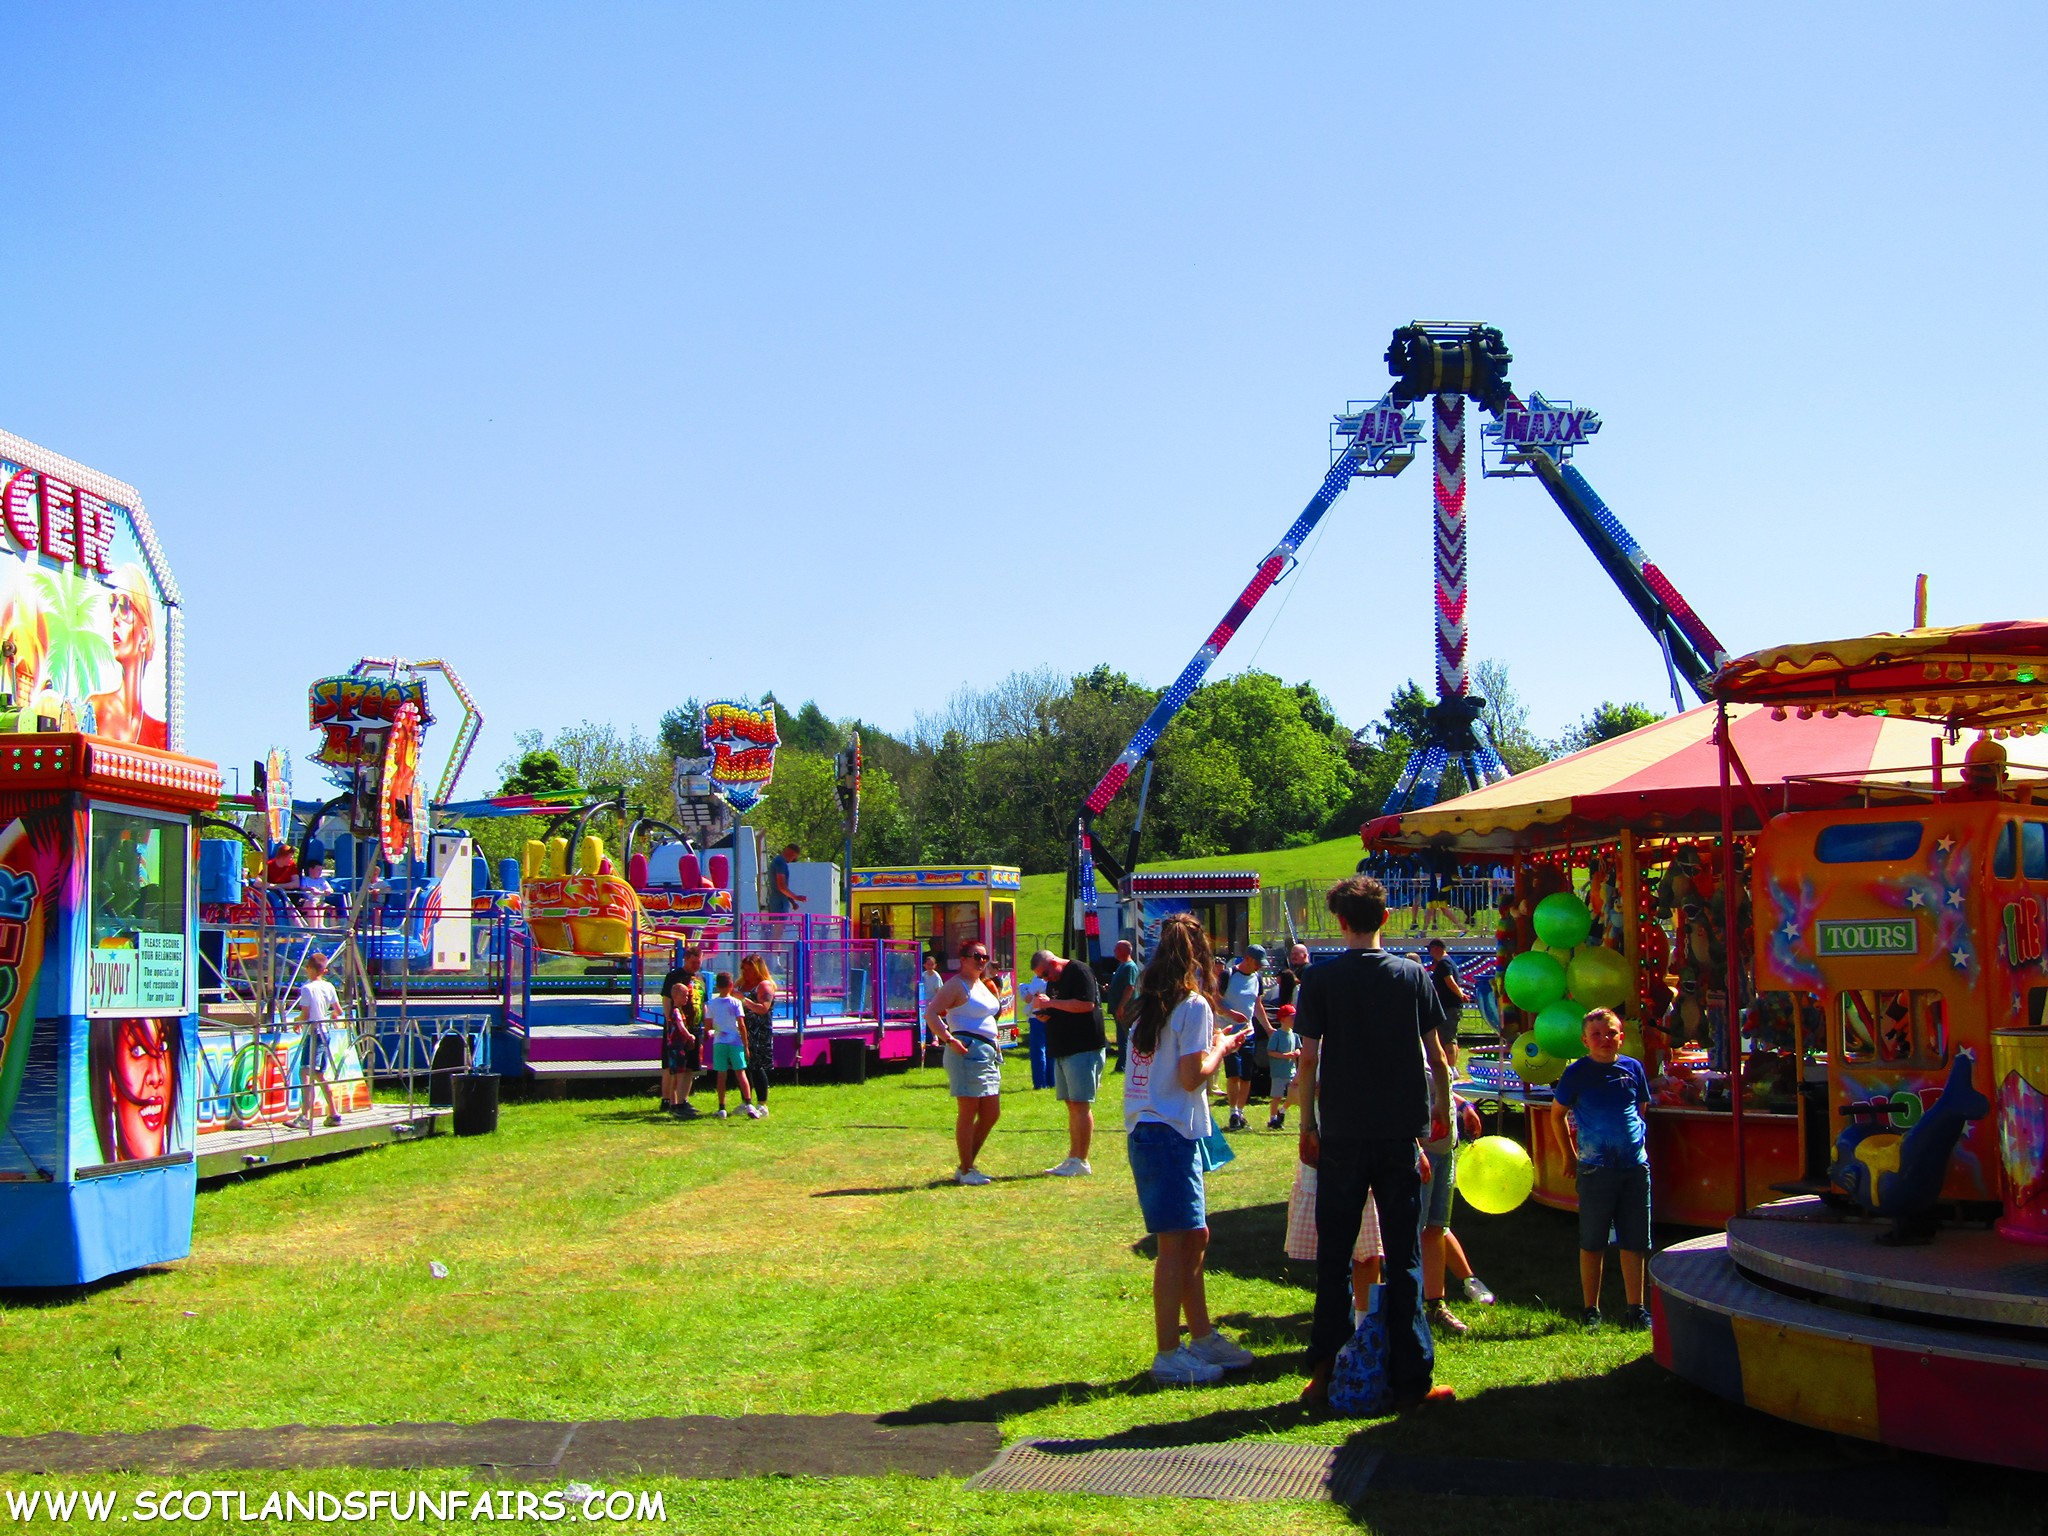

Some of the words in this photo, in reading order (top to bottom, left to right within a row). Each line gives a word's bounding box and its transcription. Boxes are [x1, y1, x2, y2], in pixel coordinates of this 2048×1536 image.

[1358, 410, 1404, 443] AIR
[1503, 411, 1585, 442] MAXX
[0, 467, 115, 575] CER
[1827, 926, 1907, 949] TOURS
[144, 938, 161, 948] PLEASE
[162, 939, 180, 949] SECURE
[141, 951, 154, 960] YOUR
[155, 951, 182, 961] BELONGINGS
[144, 967, 153, 976] The
[154, 967, 173, 978] operator
[107, 962, 130, 1008] your
[143, 980, 152, 989] not
[153, 980, 179, 990] responsible
[155, 994, 164, 1003] any
